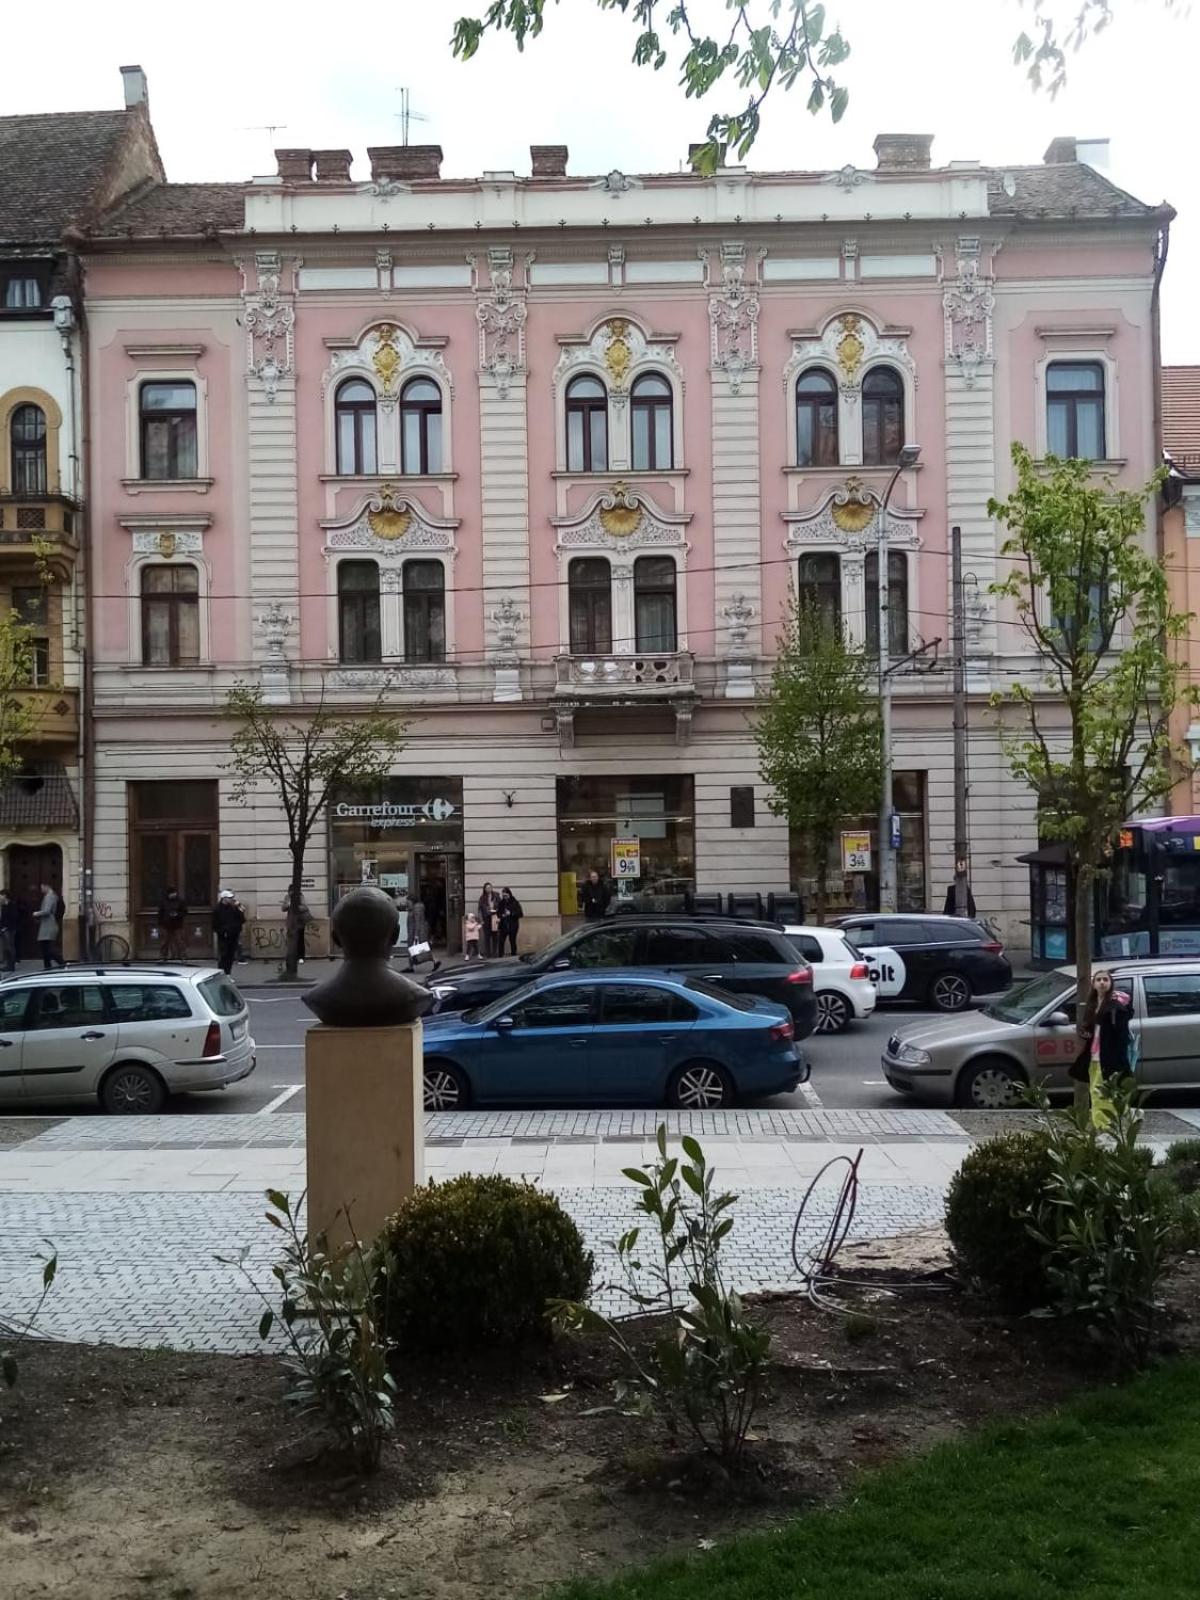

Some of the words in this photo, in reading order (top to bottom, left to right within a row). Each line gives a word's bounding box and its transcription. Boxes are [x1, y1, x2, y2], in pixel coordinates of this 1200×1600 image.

[336, 801, 416, 817] Carrefour
[370, 817, 416, 830] express
[869, 964, 895, 982] olt
